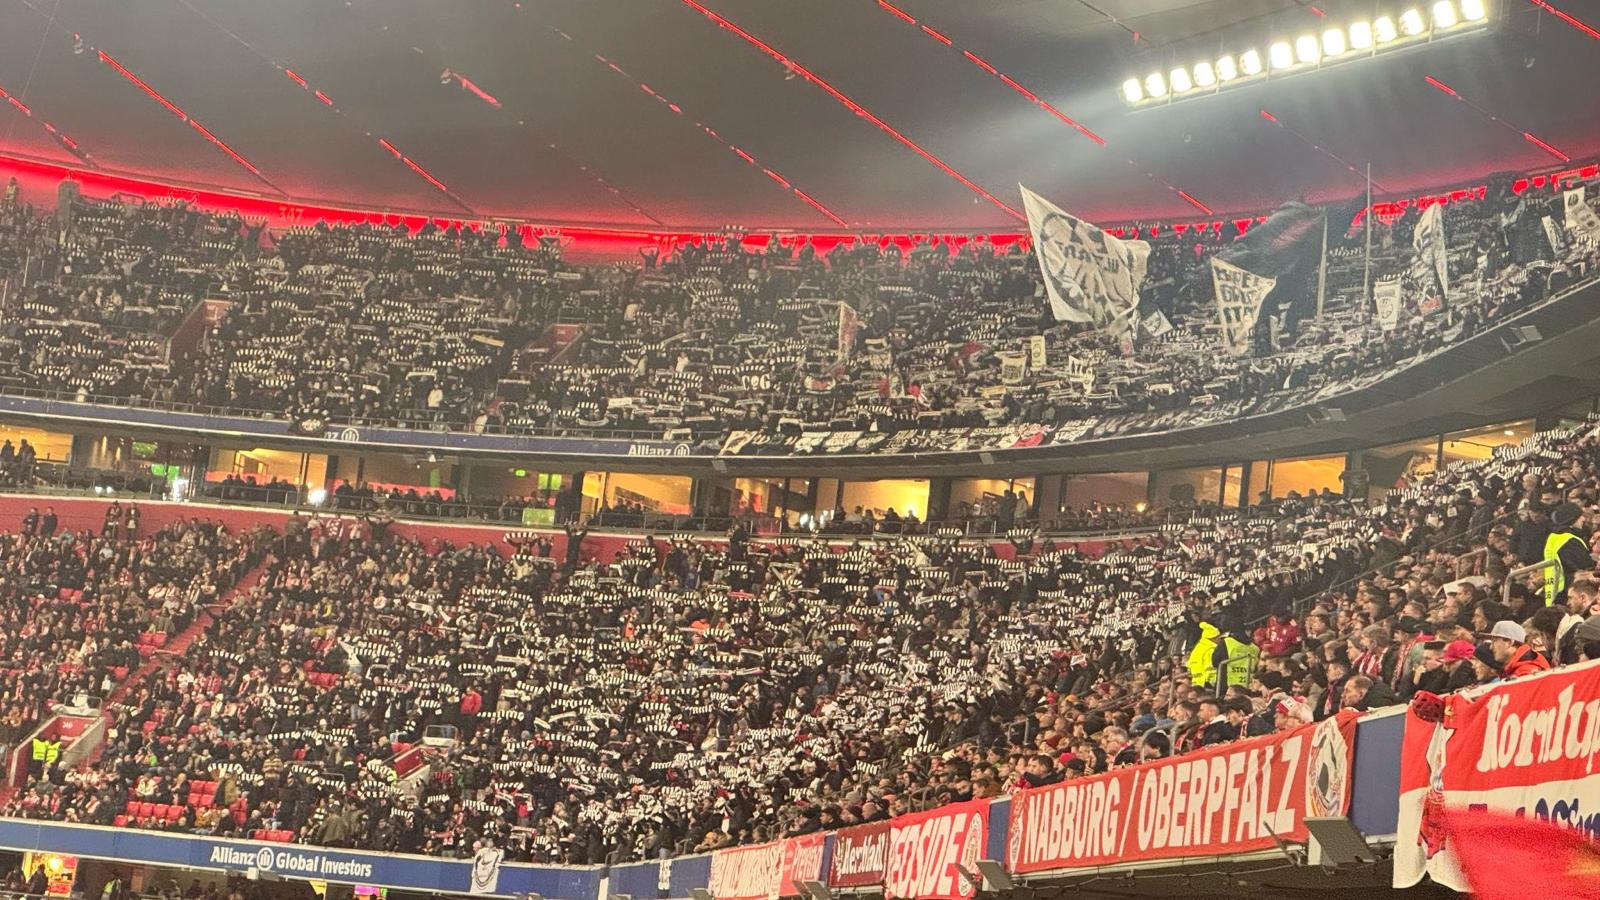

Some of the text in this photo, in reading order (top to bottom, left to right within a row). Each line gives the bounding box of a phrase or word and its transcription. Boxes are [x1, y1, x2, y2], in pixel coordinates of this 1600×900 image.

[278, 206, 305, 222] 347
[628, 444, 672, 456] Allianz
[1023, 777, 1121, 864] NABBURG
[1137, 734, 1303, 851] OBERPFALZ
[210, 846, 372, 877] Allianz Global Investors
